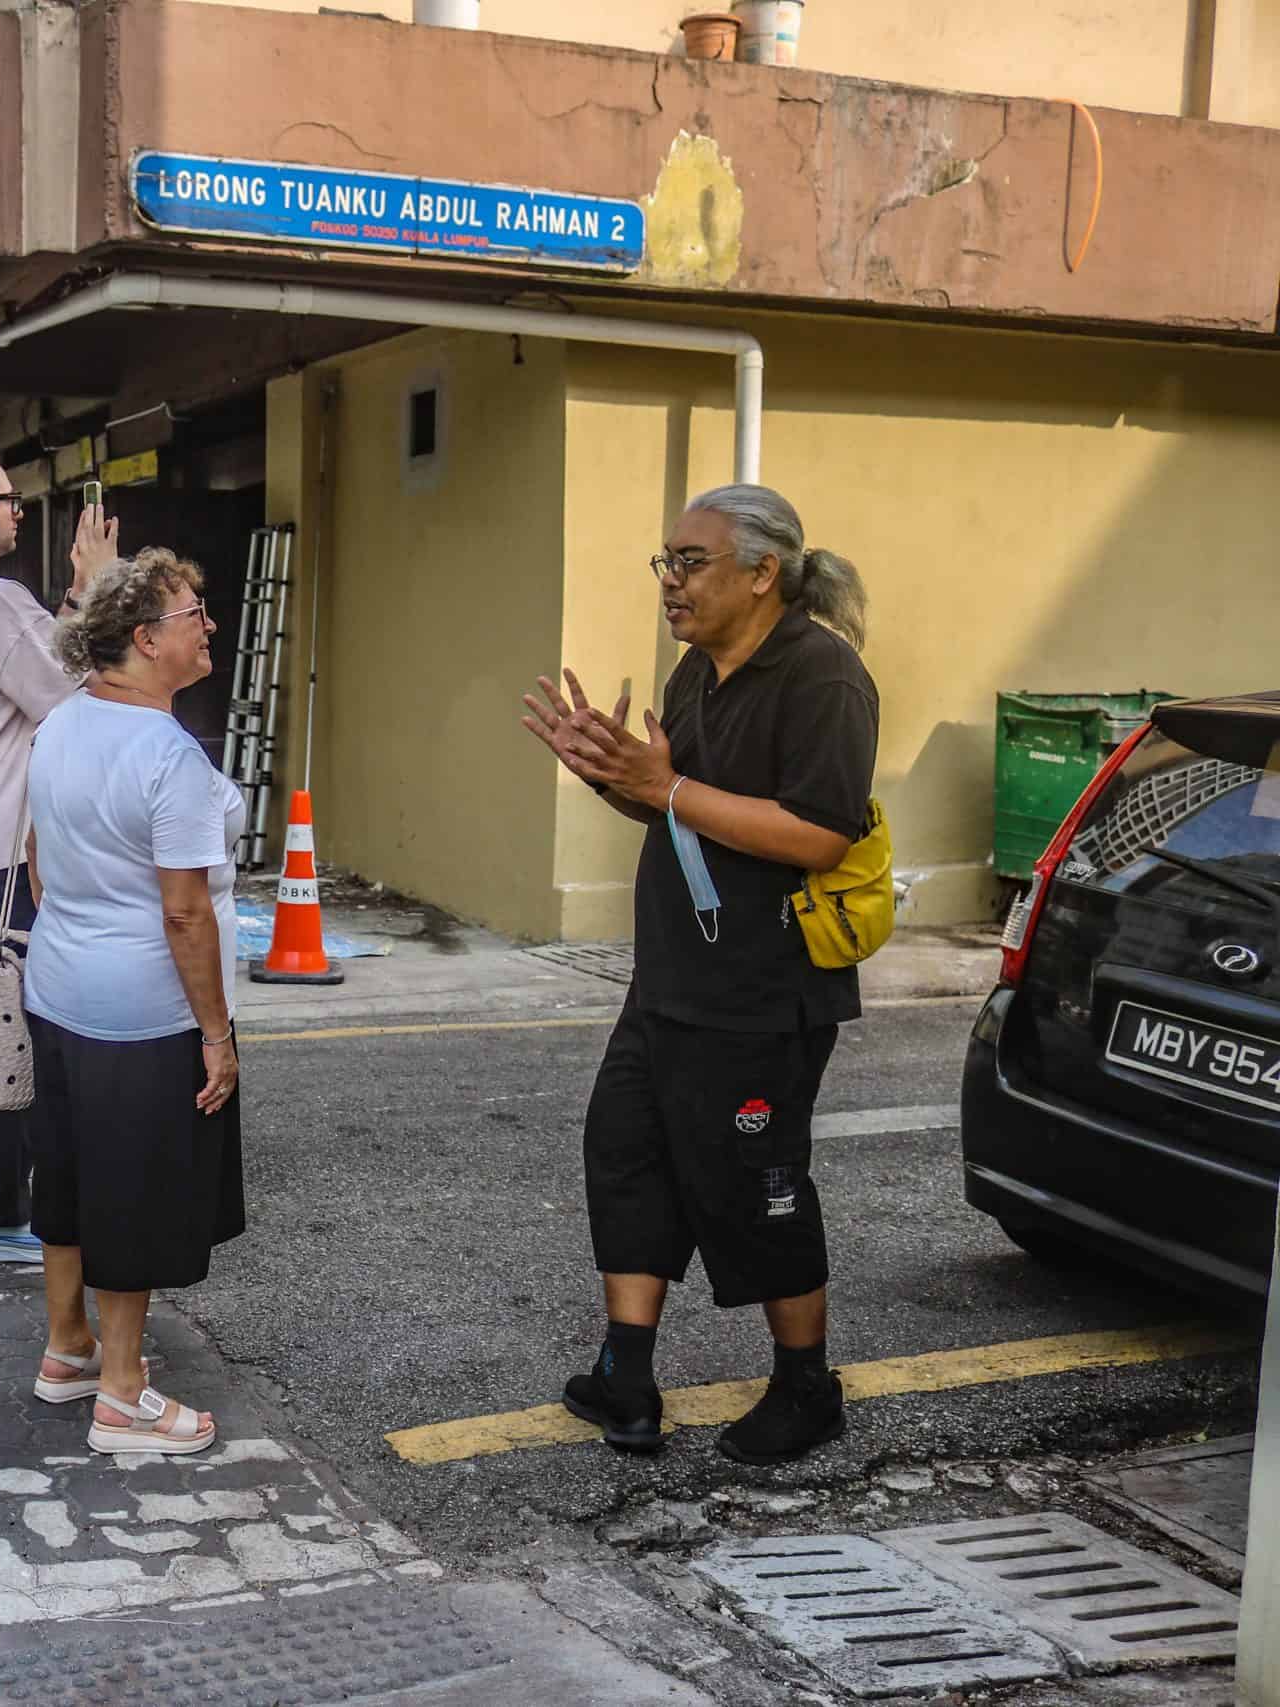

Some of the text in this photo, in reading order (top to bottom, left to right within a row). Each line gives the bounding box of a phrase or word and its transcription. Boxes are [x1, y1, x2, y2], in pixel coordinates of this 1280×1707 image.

[159, 170, 625, 241] LORONG TUANKU ABDUL RAHMAN 2
[402, 229, 439, 244] KUALA
[443, 232, 489, 247] LUMPUR
